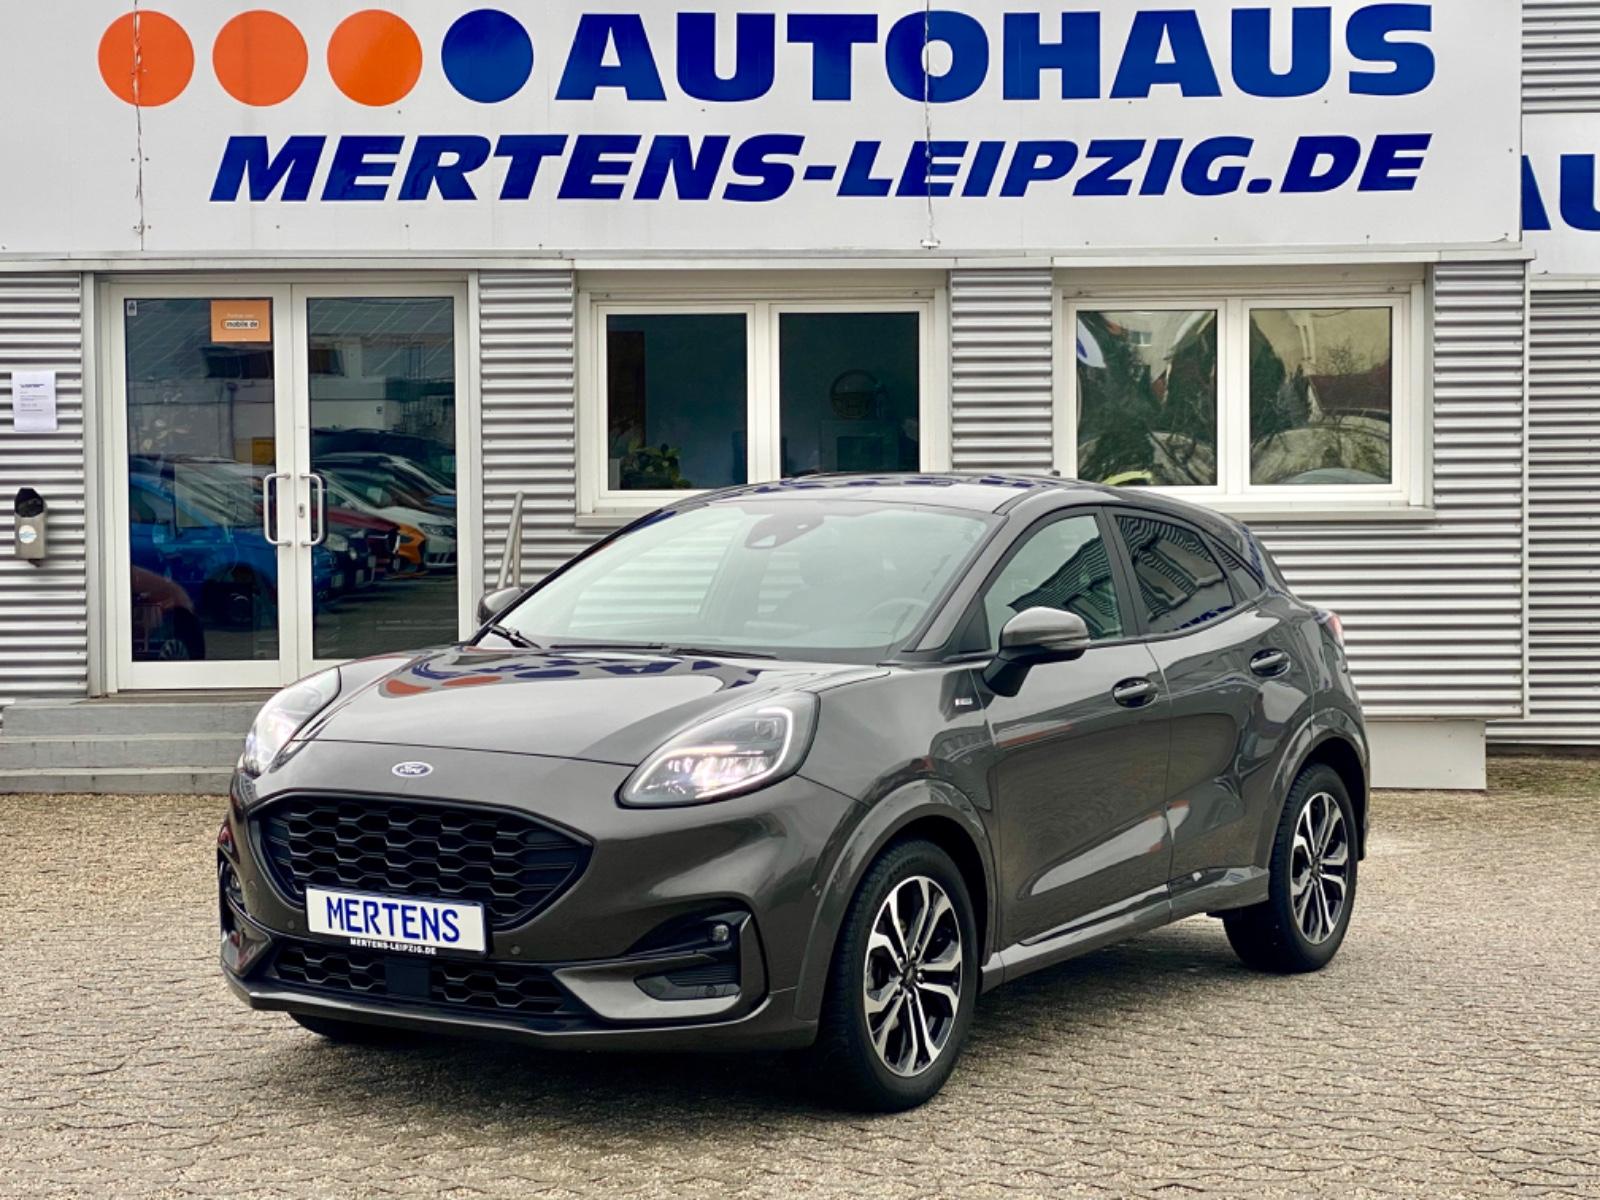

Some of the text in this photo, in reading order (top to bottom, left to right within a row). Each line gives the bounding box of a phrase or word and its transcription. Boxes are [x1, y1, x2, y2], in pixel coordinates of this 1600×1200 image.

[555, 3, 1436, 104] AUTOHAUS
[210, 133, 1432, 203] MERTENS-LEIPZIG.DE
[326, 897, 460, 943] MERTENS
[350, 937, 437, 955] MERTENS-LEIPZIG.DE
